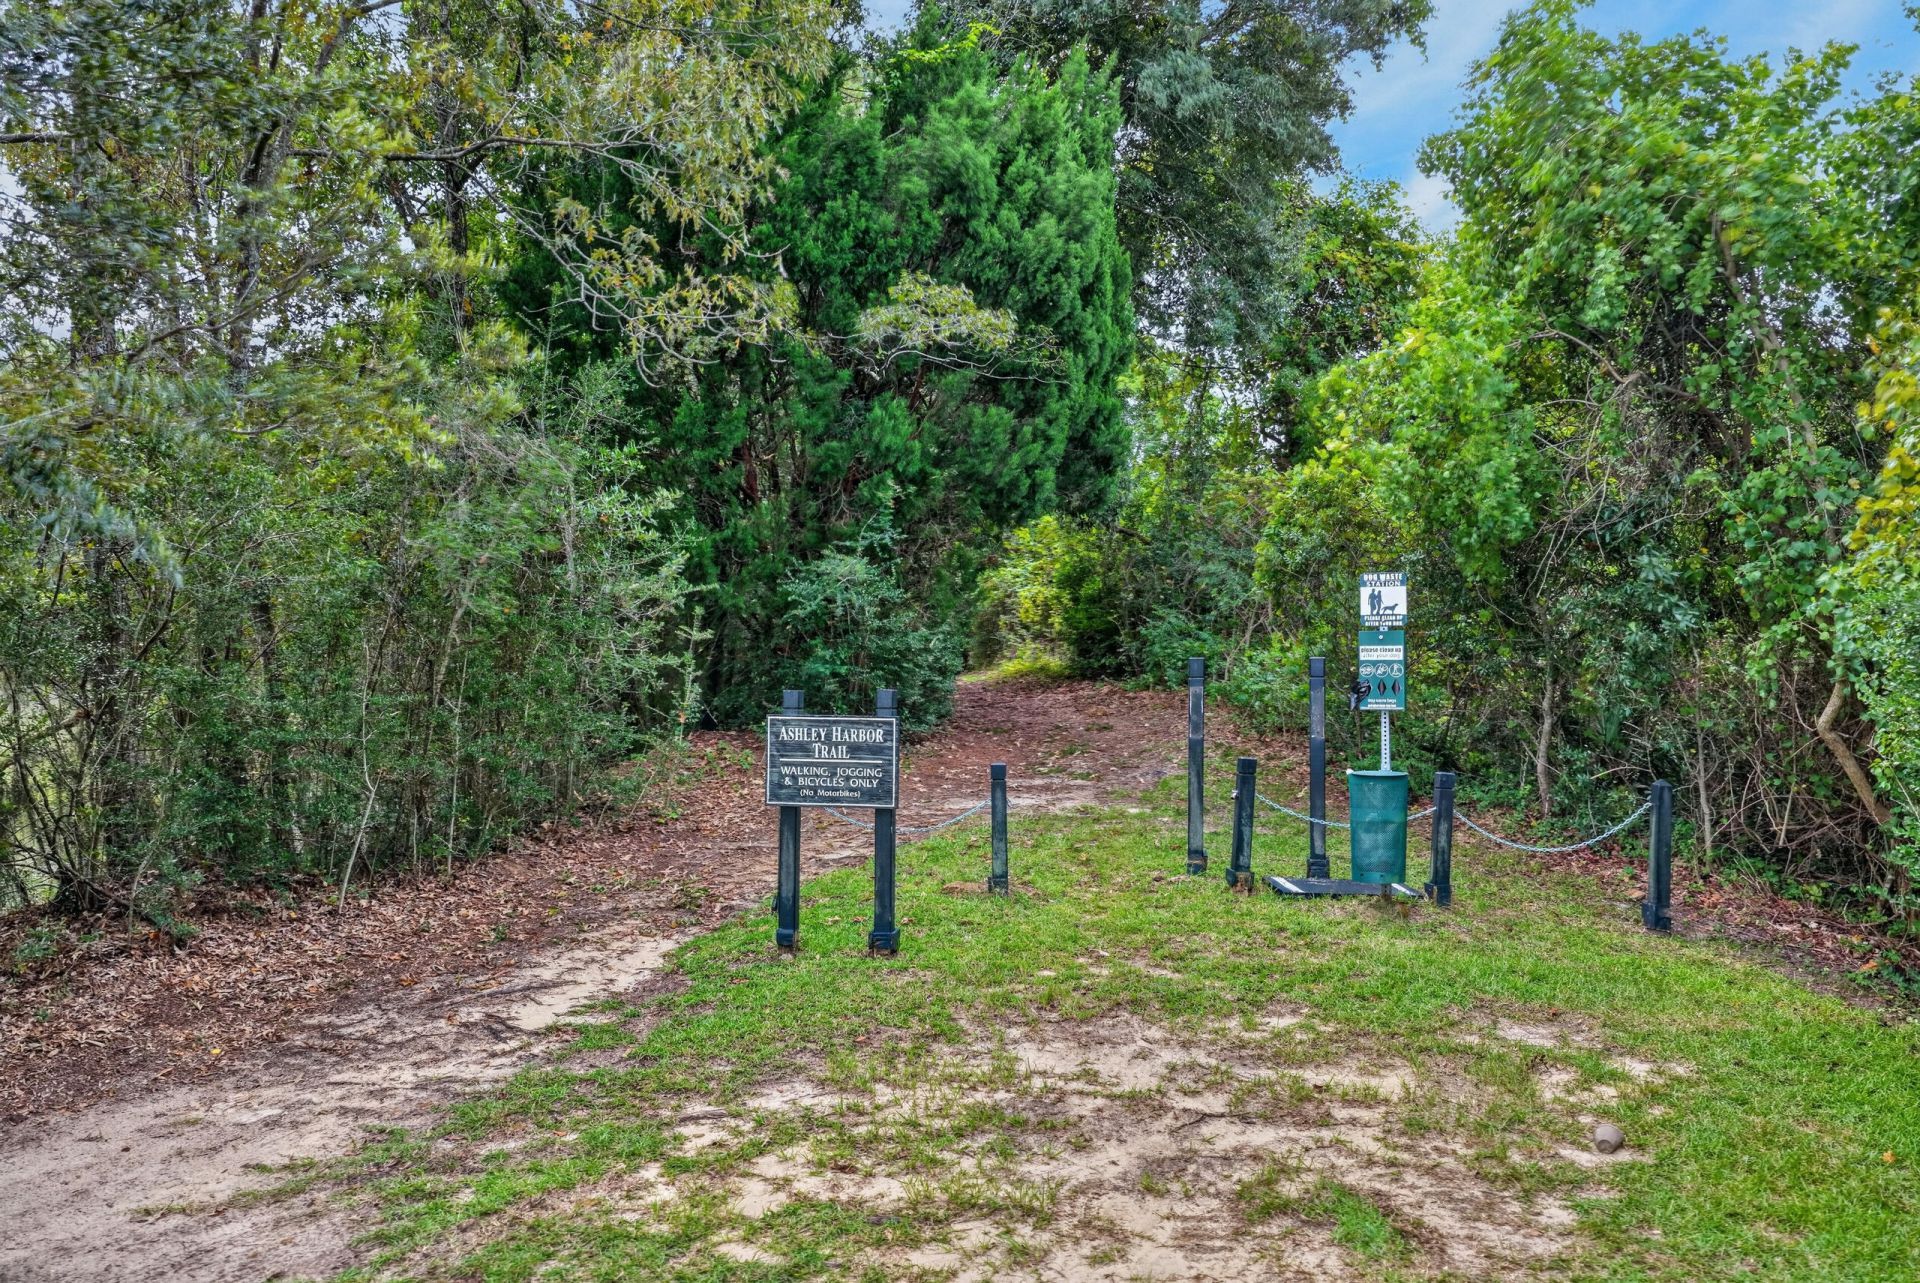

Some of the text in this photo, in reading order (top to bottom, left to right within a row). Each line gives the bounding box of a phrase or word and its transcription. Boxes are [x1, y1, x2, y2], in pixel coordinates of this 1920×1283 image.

[1379, 573, 1403, 581] WASTE
[780, 726, 884, 743] ASHLEY HARBOR
[813, 743, 850, 759] TRAIL
[780, 766, 883, 778] WALKING, JOGGING
[784, 776, 880, 788] & BICYCLES ONLY
[800, 789, 861, 799] (No Motorbikes)
